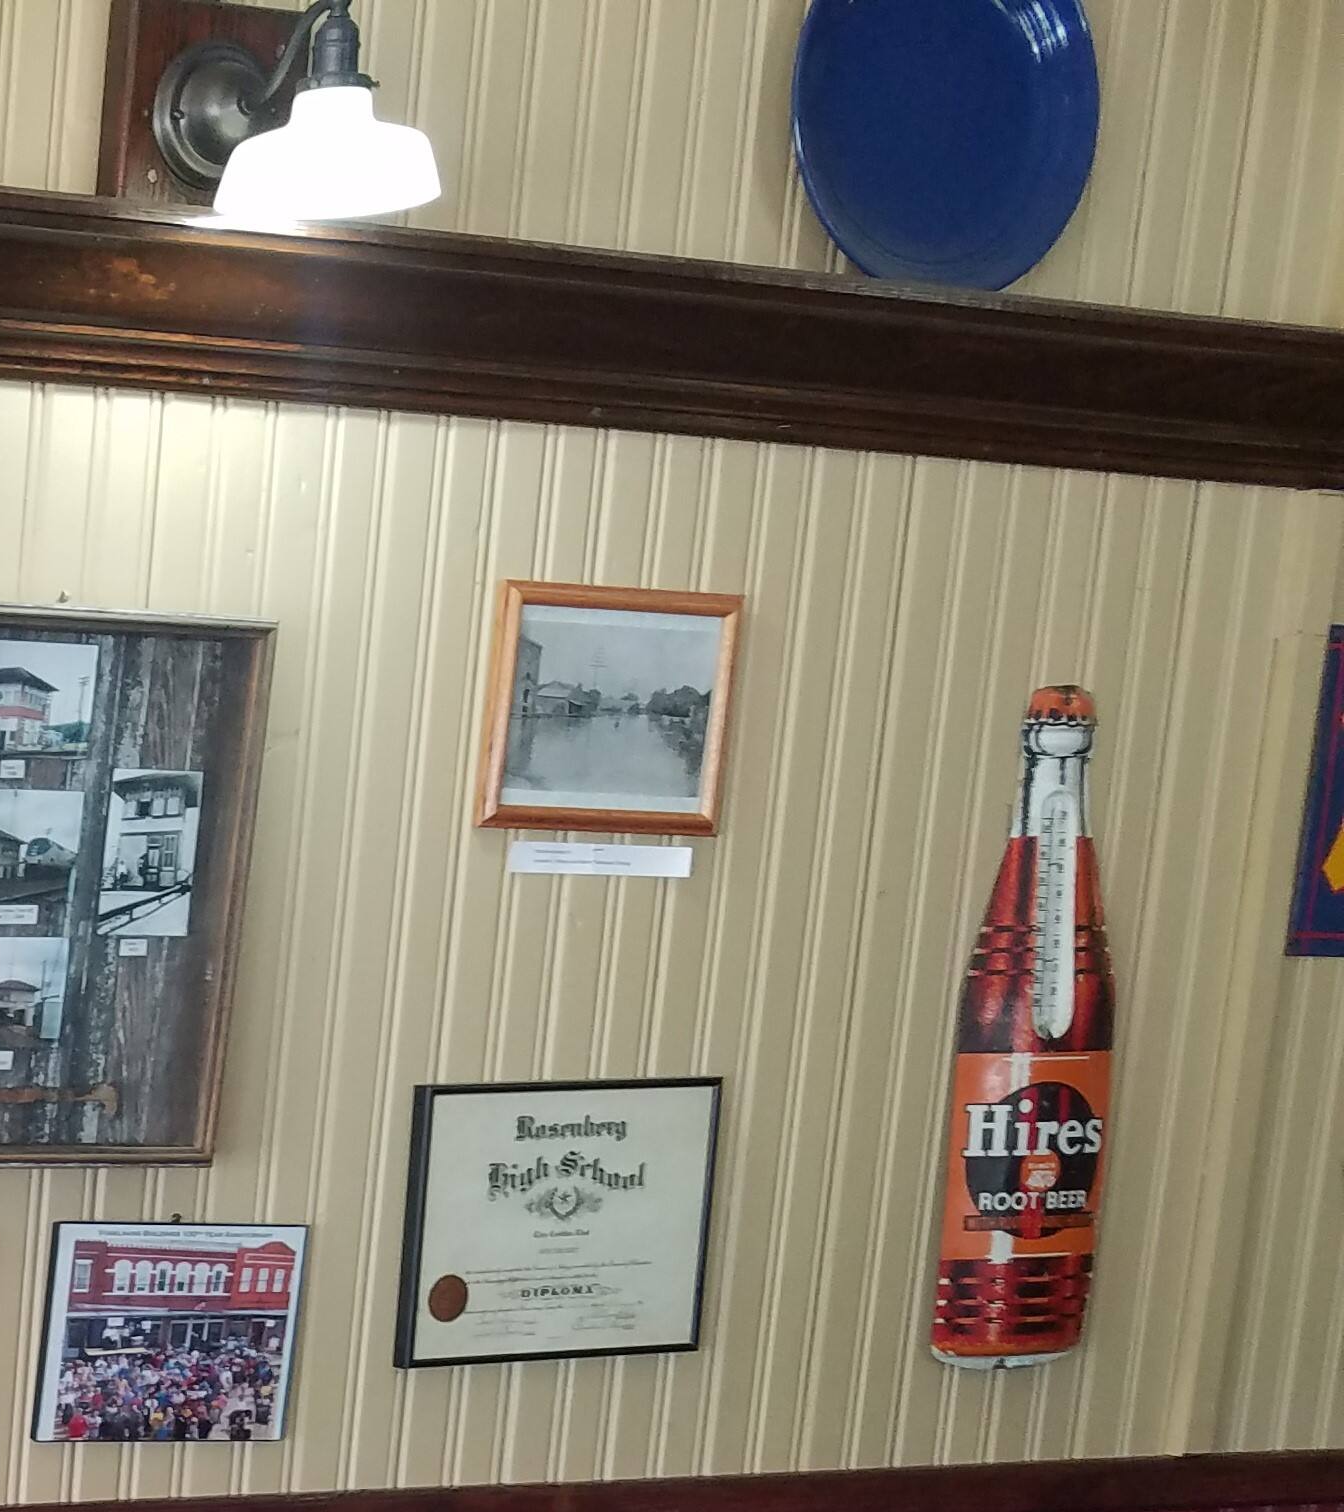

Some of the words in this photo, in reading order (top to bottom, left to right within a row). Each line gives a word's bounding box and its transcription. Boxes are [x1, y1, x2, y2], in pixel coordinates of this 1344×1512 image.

[514, 1114, 628, 1142] Rosenberg
[961, 1098, 1103, 1156] Hires
[978, 1191, 1040, 1211] ROOT
[1045, 1189, 1088, 1210] BEER
